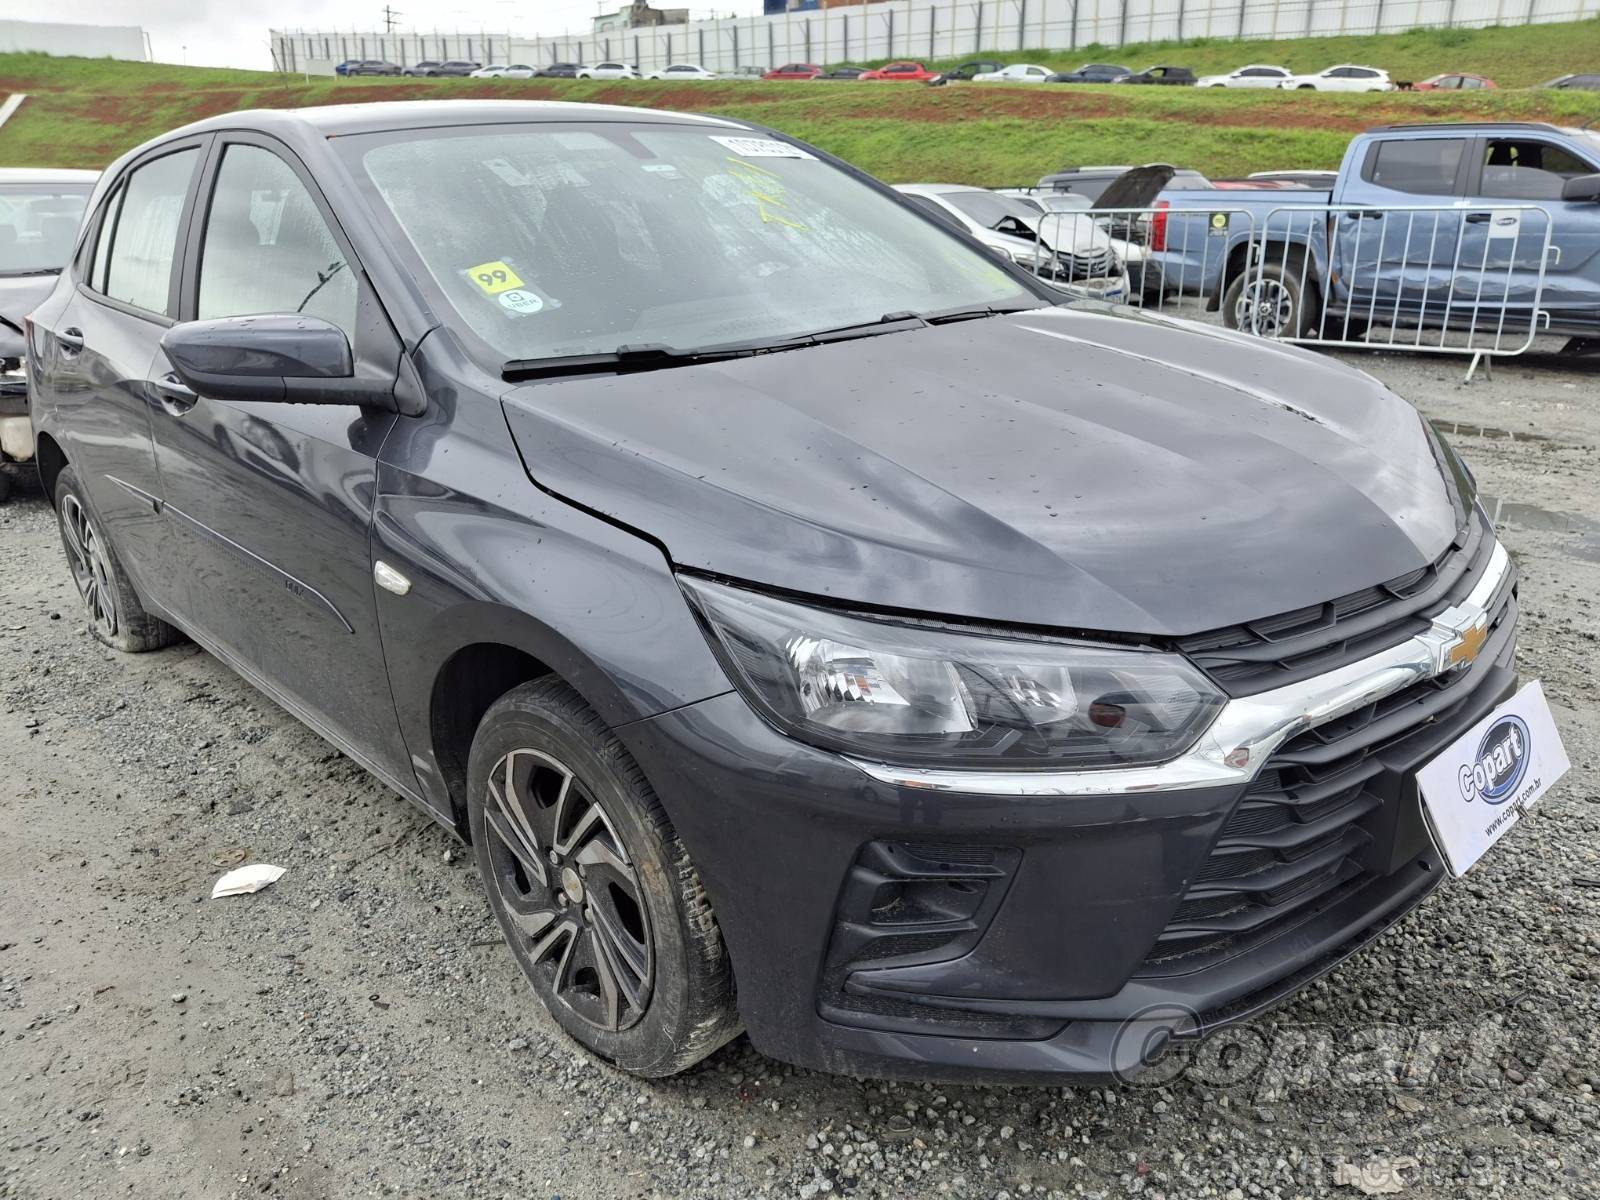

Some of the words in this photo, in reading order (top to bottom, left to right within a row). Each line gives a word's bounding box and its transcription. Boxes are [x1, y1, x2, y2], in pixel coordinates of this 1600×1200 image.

[478, 269, 507, 287] 99
[1458, 722, 1523, 803] Copart
[1485, 777, 1542, 837] www.copart.com.br
